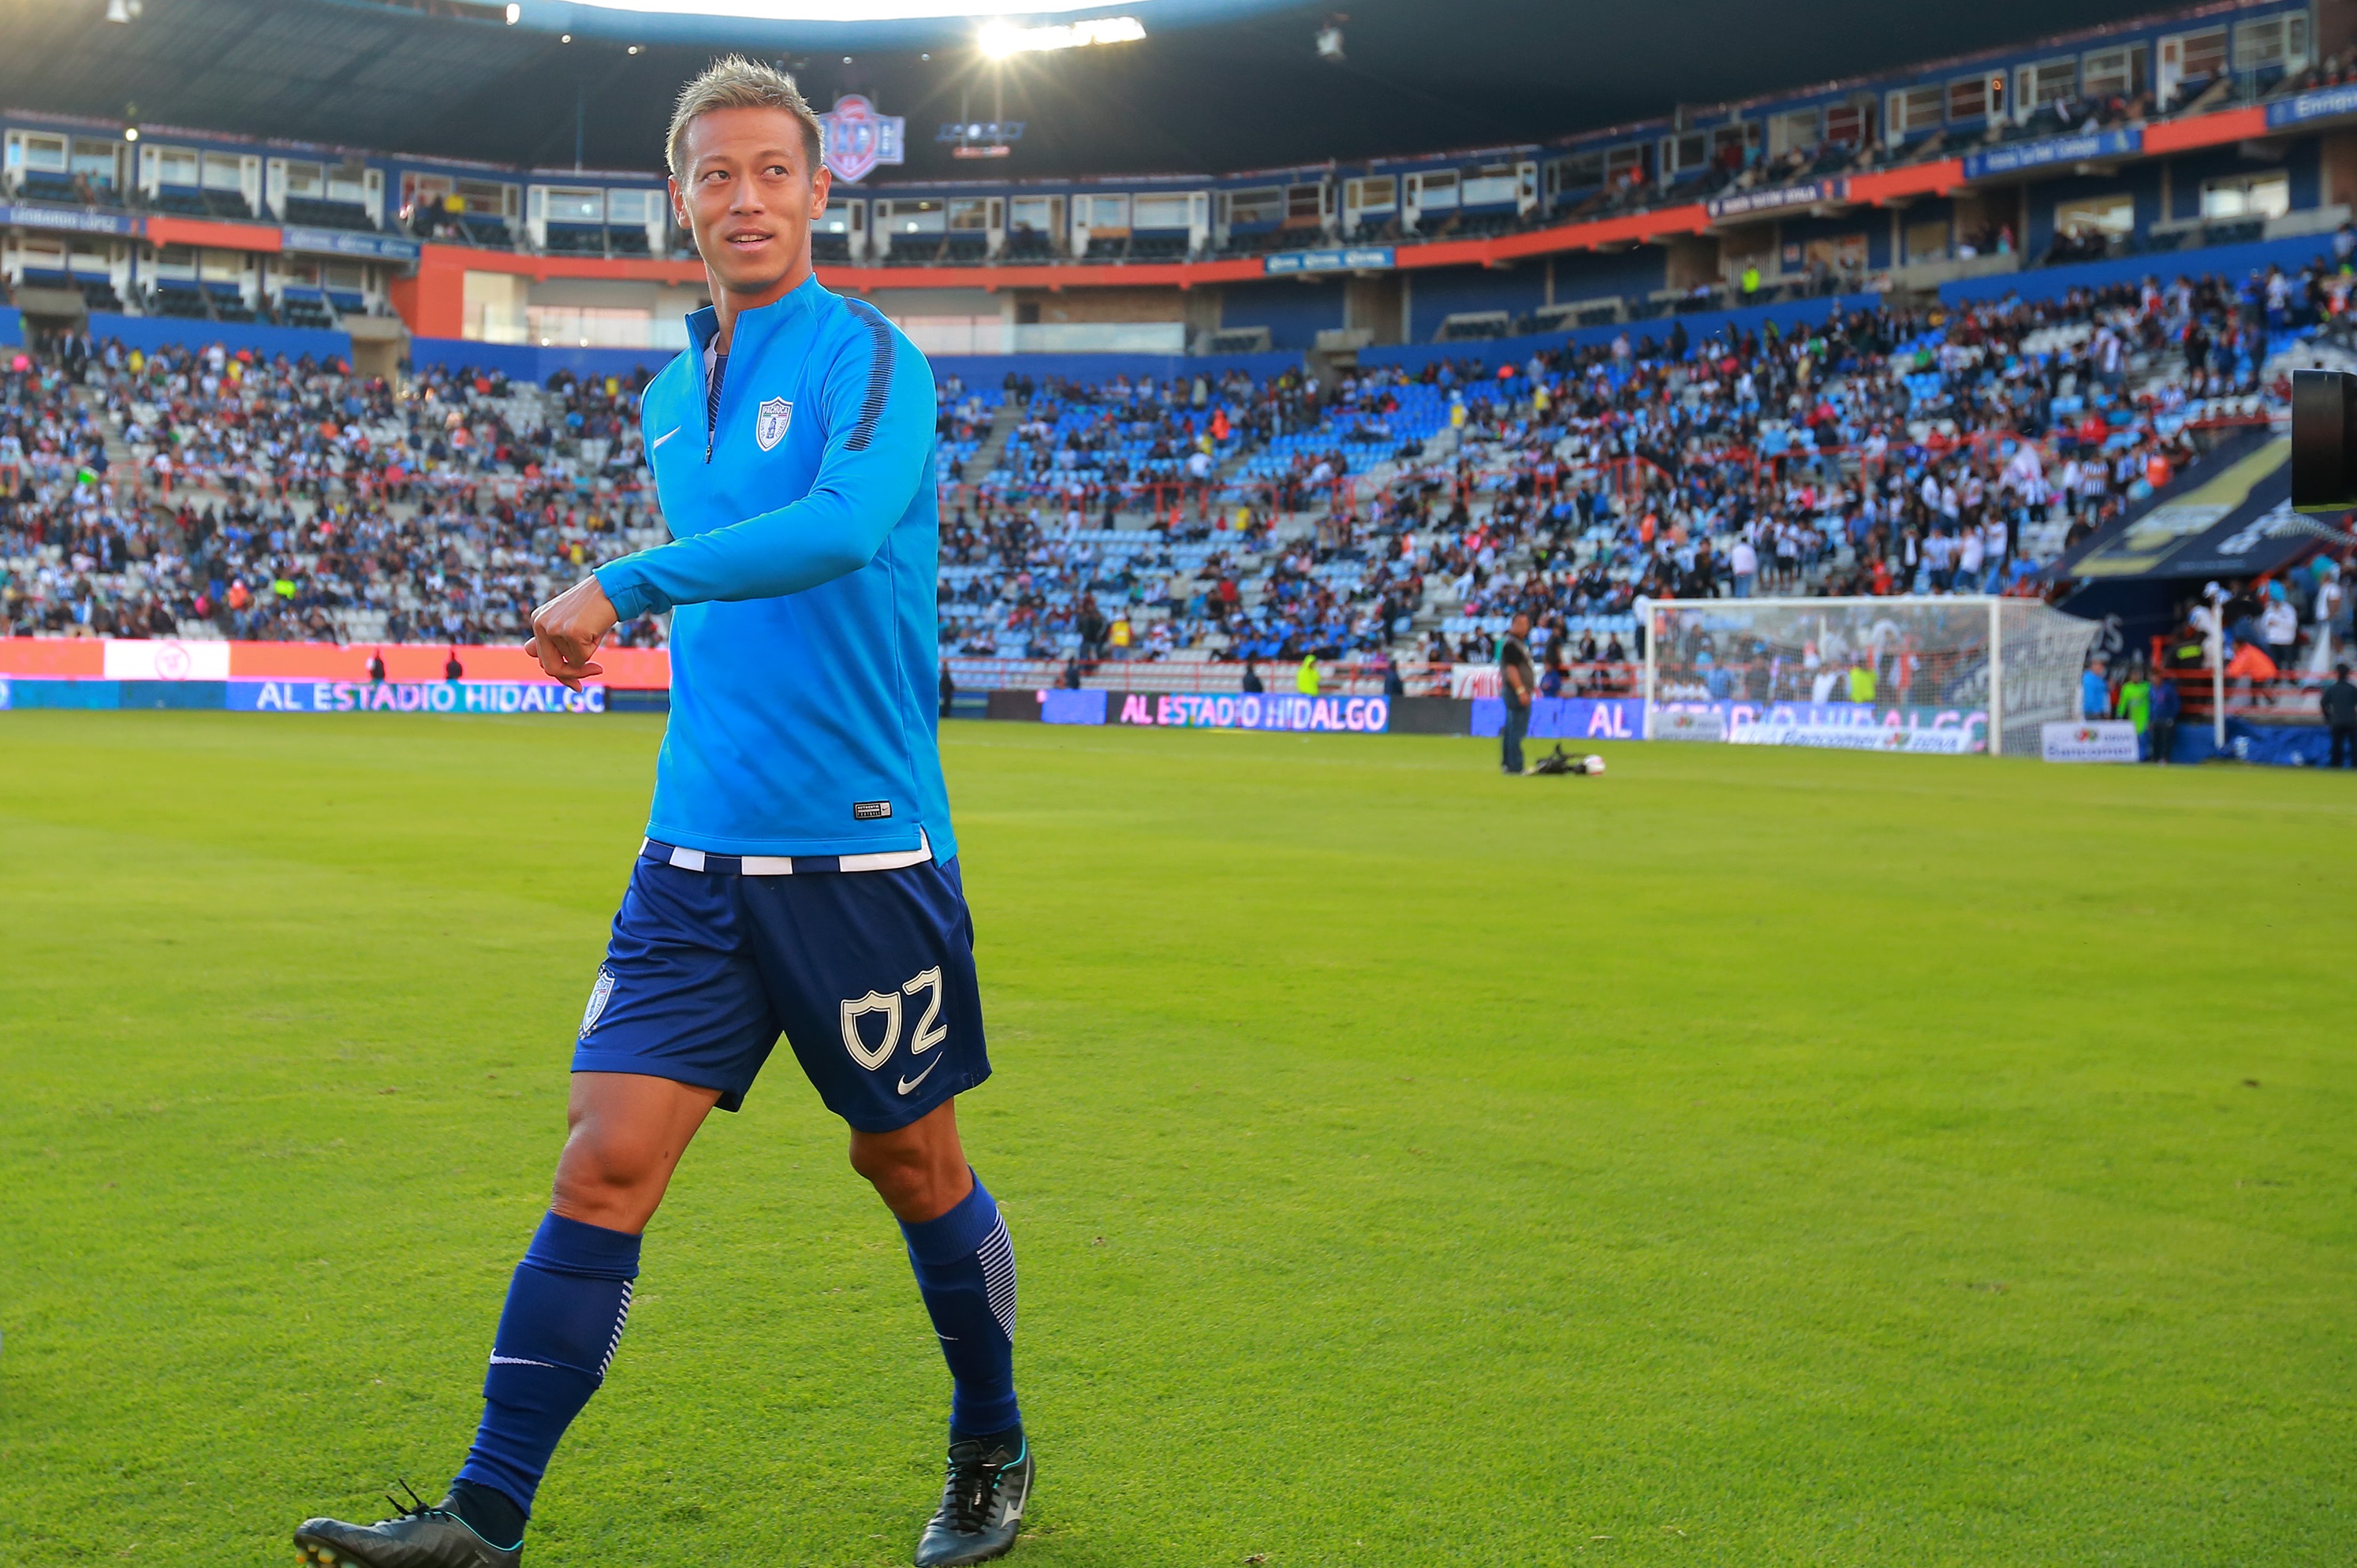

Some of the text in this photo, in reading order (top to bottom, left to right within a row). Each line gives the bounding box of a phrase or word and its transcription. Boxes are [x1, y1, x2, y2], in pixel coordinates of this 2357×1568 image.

[763, 404, 788, 414] PACHUCA
[255, 682, 303, 710] AL
[313, 682, 457, 711] ESTADIO
[1121, 694, 1388, 732] AL ESTADIO HIDALGO
[1587, 702, 1632, 738] AL
